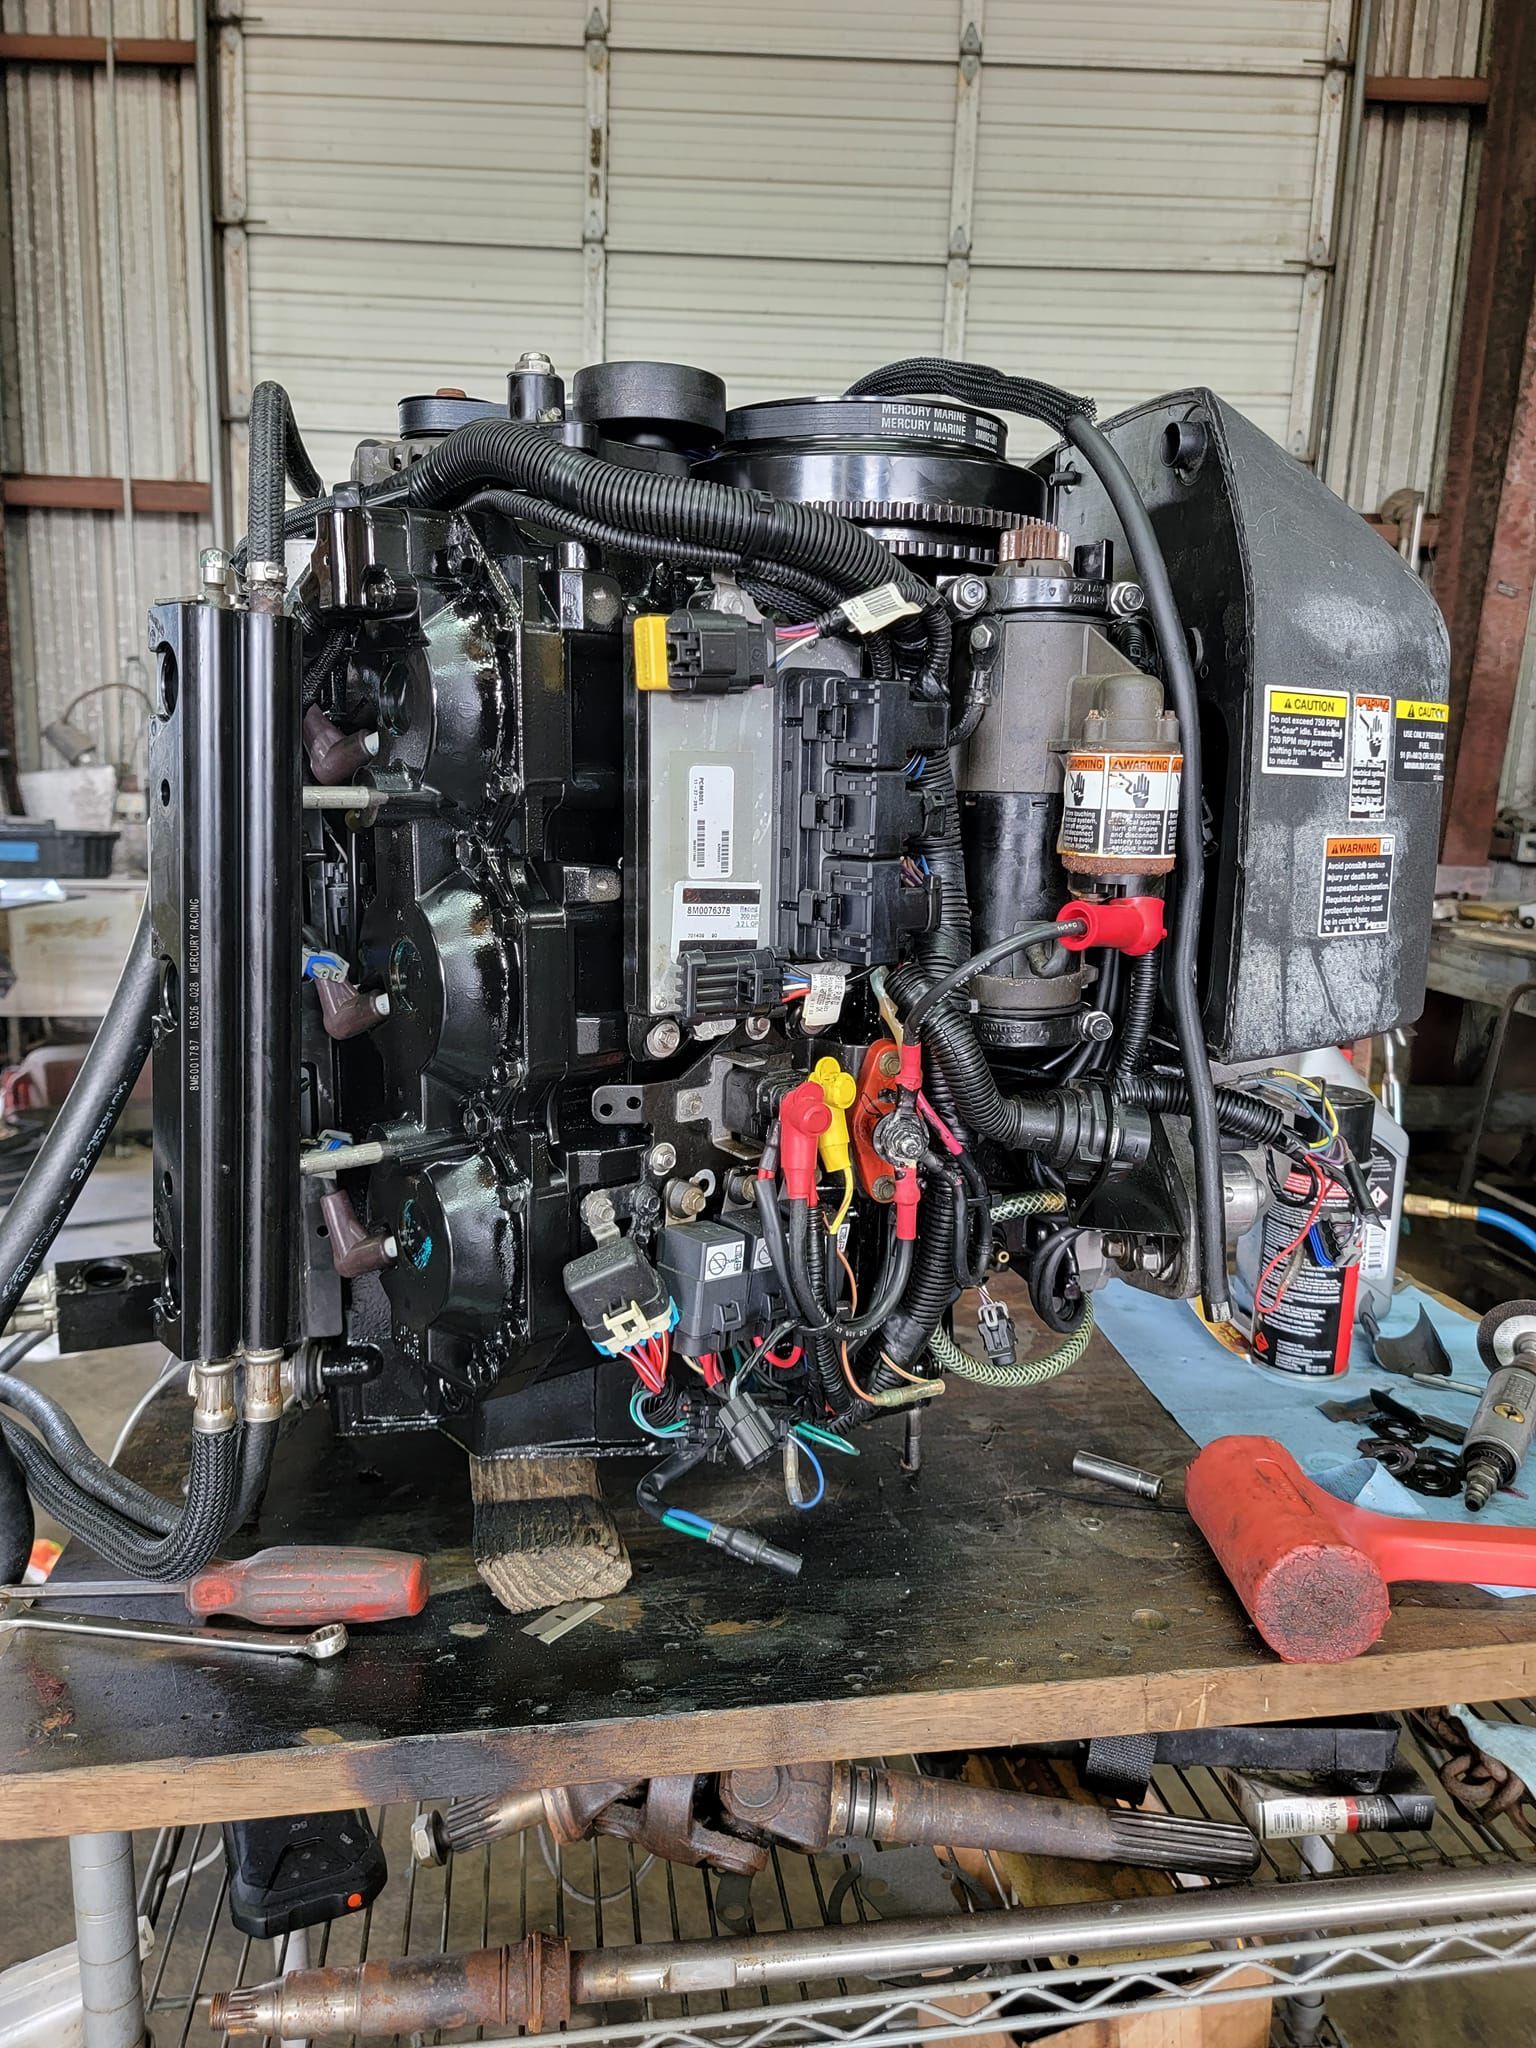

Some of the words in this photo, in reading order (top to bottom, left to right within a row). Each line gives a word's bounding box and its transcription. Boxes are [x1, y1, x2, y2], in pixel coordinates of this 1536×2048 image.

[881, 404, 931, 416] MERCURY
[934, 407, 966, 422] MARINE
[881, 418, 930, 430] MERCURY
[934, 422, 966, 436] MARINE
[1294, 698, 1335, 712] CAUTION
[1270, 715, 1280, 723] Do
[1281, 716, 1291, 724] not
[1315, 718, 1325, 726] 750
[1326, 719, 1339, 727] RPM
[1403, 730, 1412, 738] USE
[1270, 736, 1281, 744] 750
[1282, 736, 1296, 744] RPM
[1298, 739, 1310, 747] may
[1270, 746, 1291, 756] shifting
[1293, 747, 1306, 756] from
[1123, 760, 1168, 770] WARNING
[1339, 843, 1377, 853] WARNING
[1328, 862, 1344, 870] Avoid
[1345, 861, 1367, 871] possible
[1327, 873, 1343, 882] injury
[1351, 872, 1366, 880] death
[1326, 884, 1358, 893] unexpected
[1326, 895, 1350, 904] Required
[190, 898, 200, 930] RACING
[687, 906, 731, 915] 8M0076378
[1324, 906, 1352, 916] protection
[1371, 904, 1383, 912] must
[1339, 916, 1357, 924] control
[190, 934, 200, 974] MERCURY
[955, 976, 970, 987] SAE
[190, 1040, 200, 1091] 8M6001787
